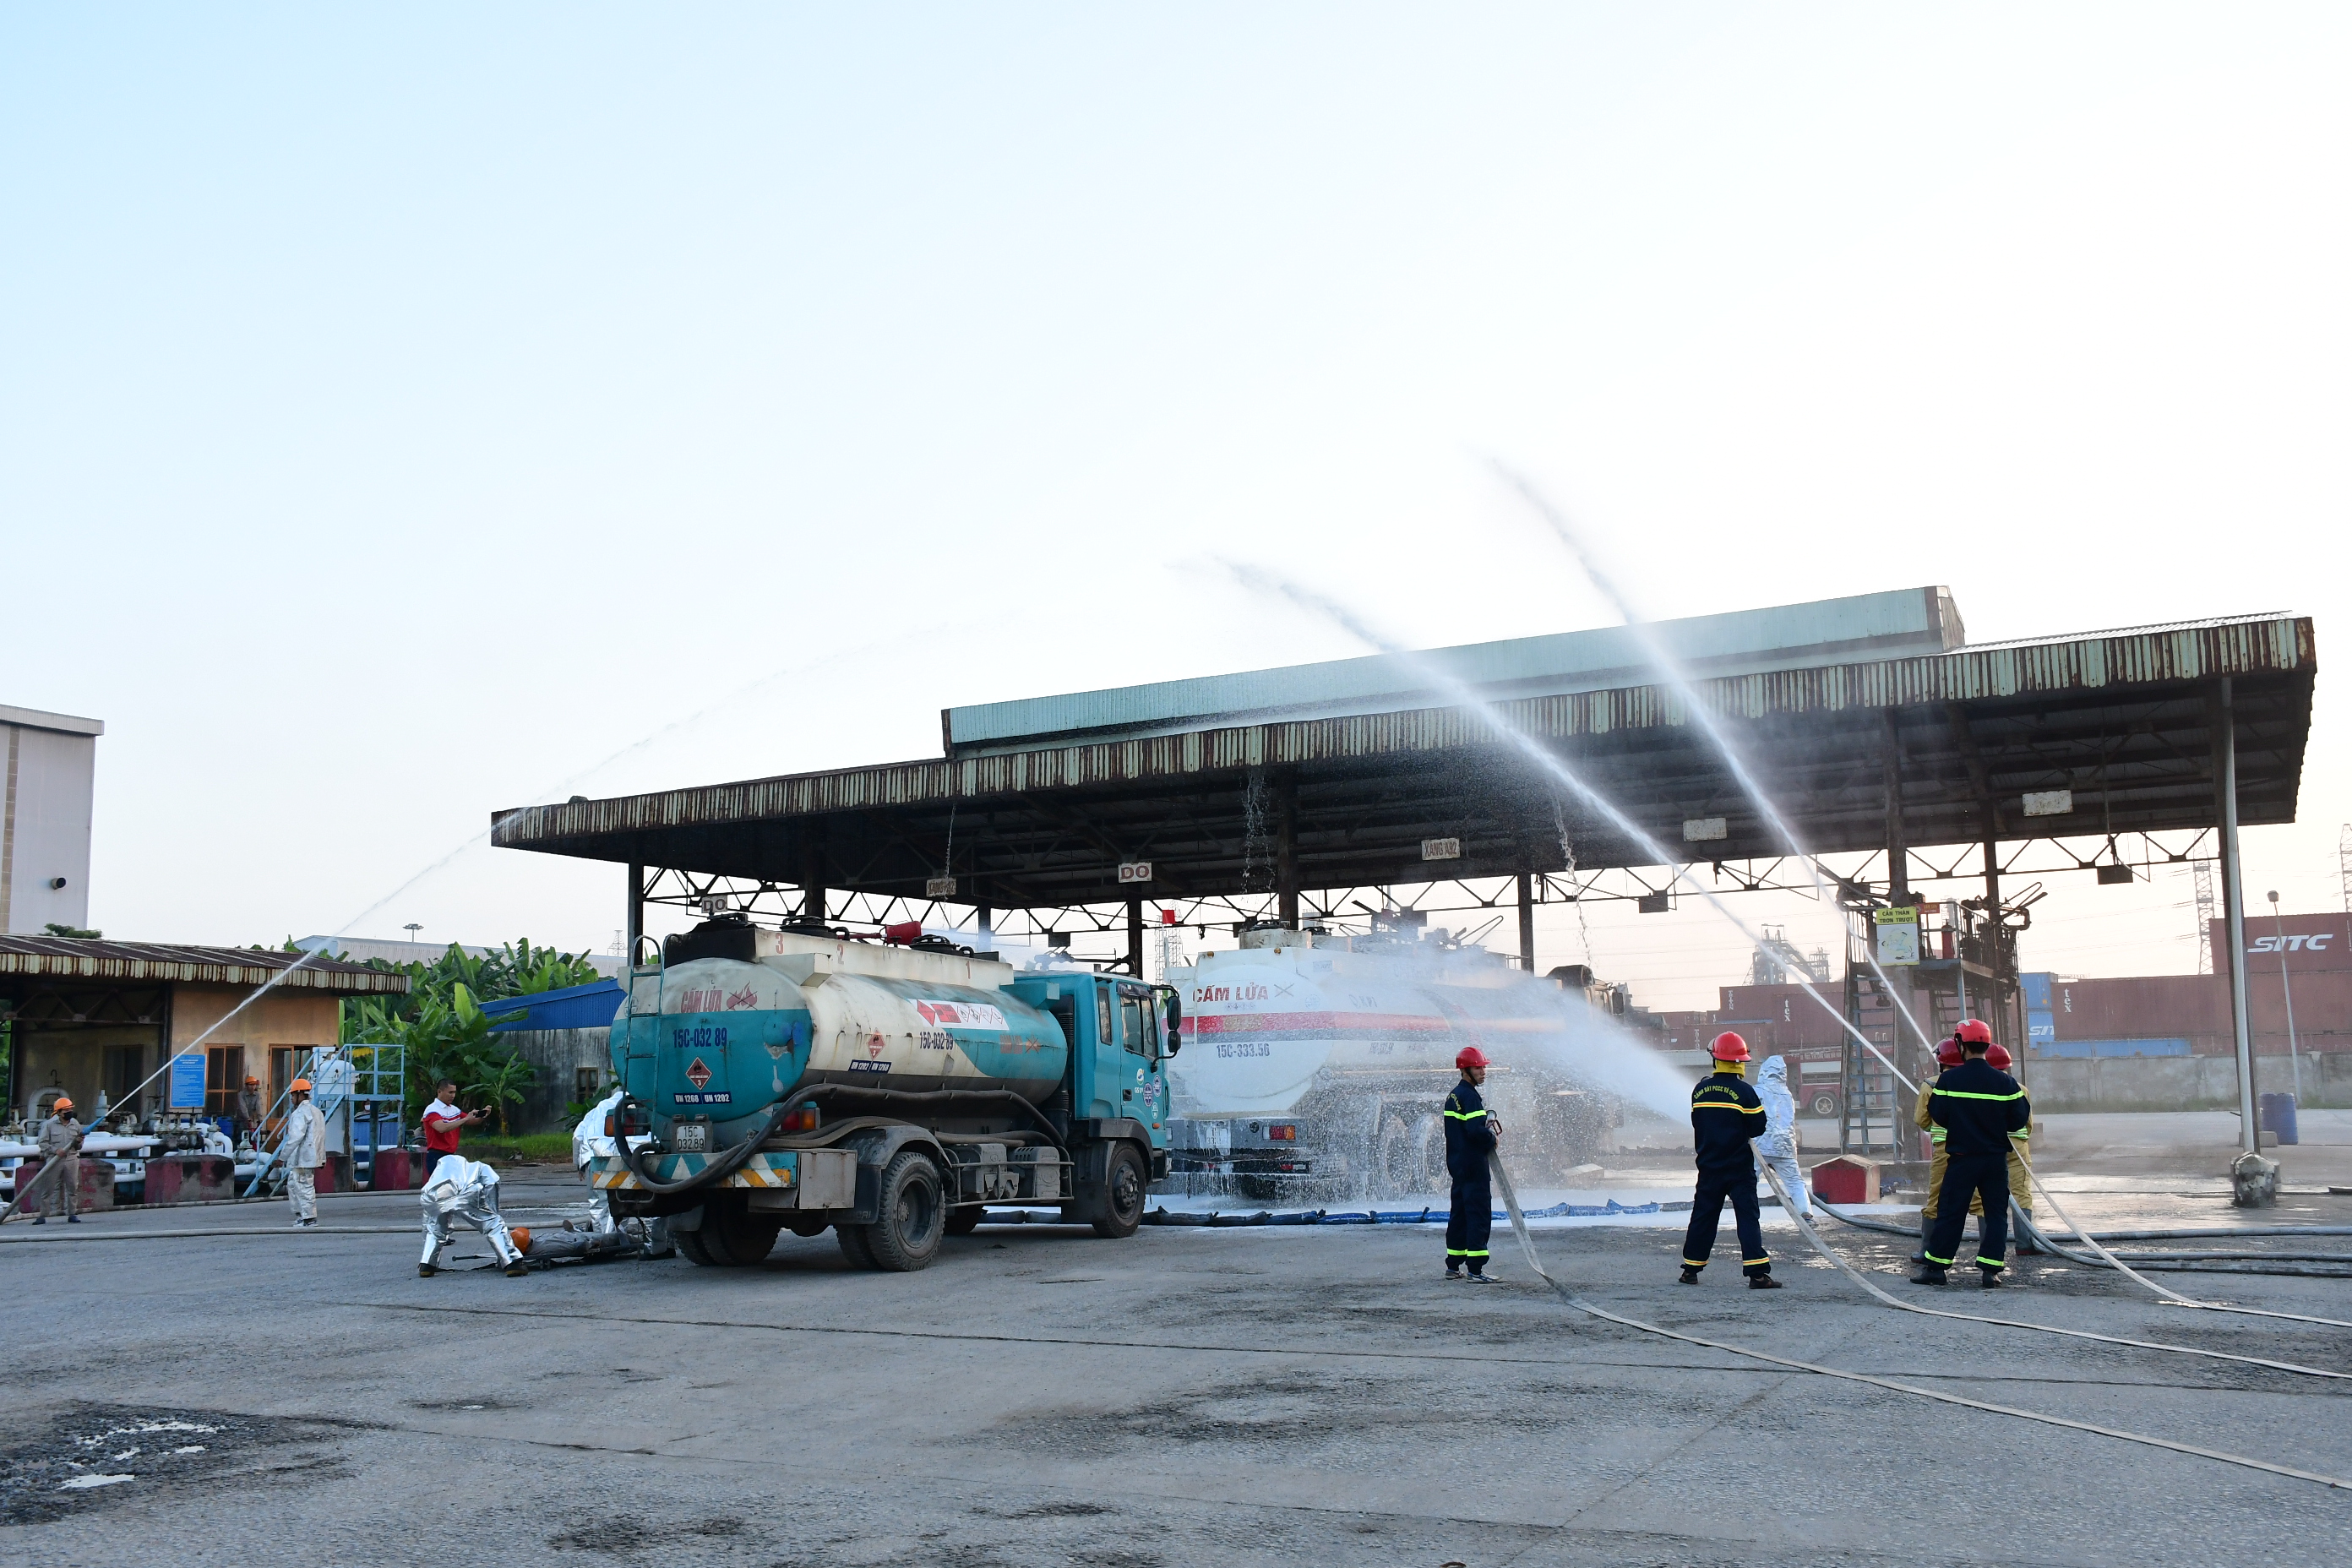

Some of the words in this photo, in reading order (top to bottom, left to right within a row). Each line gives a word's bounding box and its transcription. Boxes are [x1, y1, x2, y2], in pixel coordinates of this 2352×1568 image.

[1121, 865, 1150, 879] DO
[703, 898, 726, 912] DO
[775, 932, 784, 955] 3
[2247, 934, 2333, 953] SITC
[836, 943, 844, 965] 2
[966, 961, 971, 979] 1
[1192, 985, 1229, 1003] CẤM
[1236, 982, 1269, 1001] LỬA
[2028, 1025, 2055, 1036] SIT
[1217, 1043, 1270, 1059] 15C-333.56
[675, 1094, 684, 1102] UN
[684, 1094, 700, 1102] 1268
[704, 1094, 714, 1102] UN
[714, 1093, 730, 1102] 1202
[683, 1126, 699, 1138] 15C
